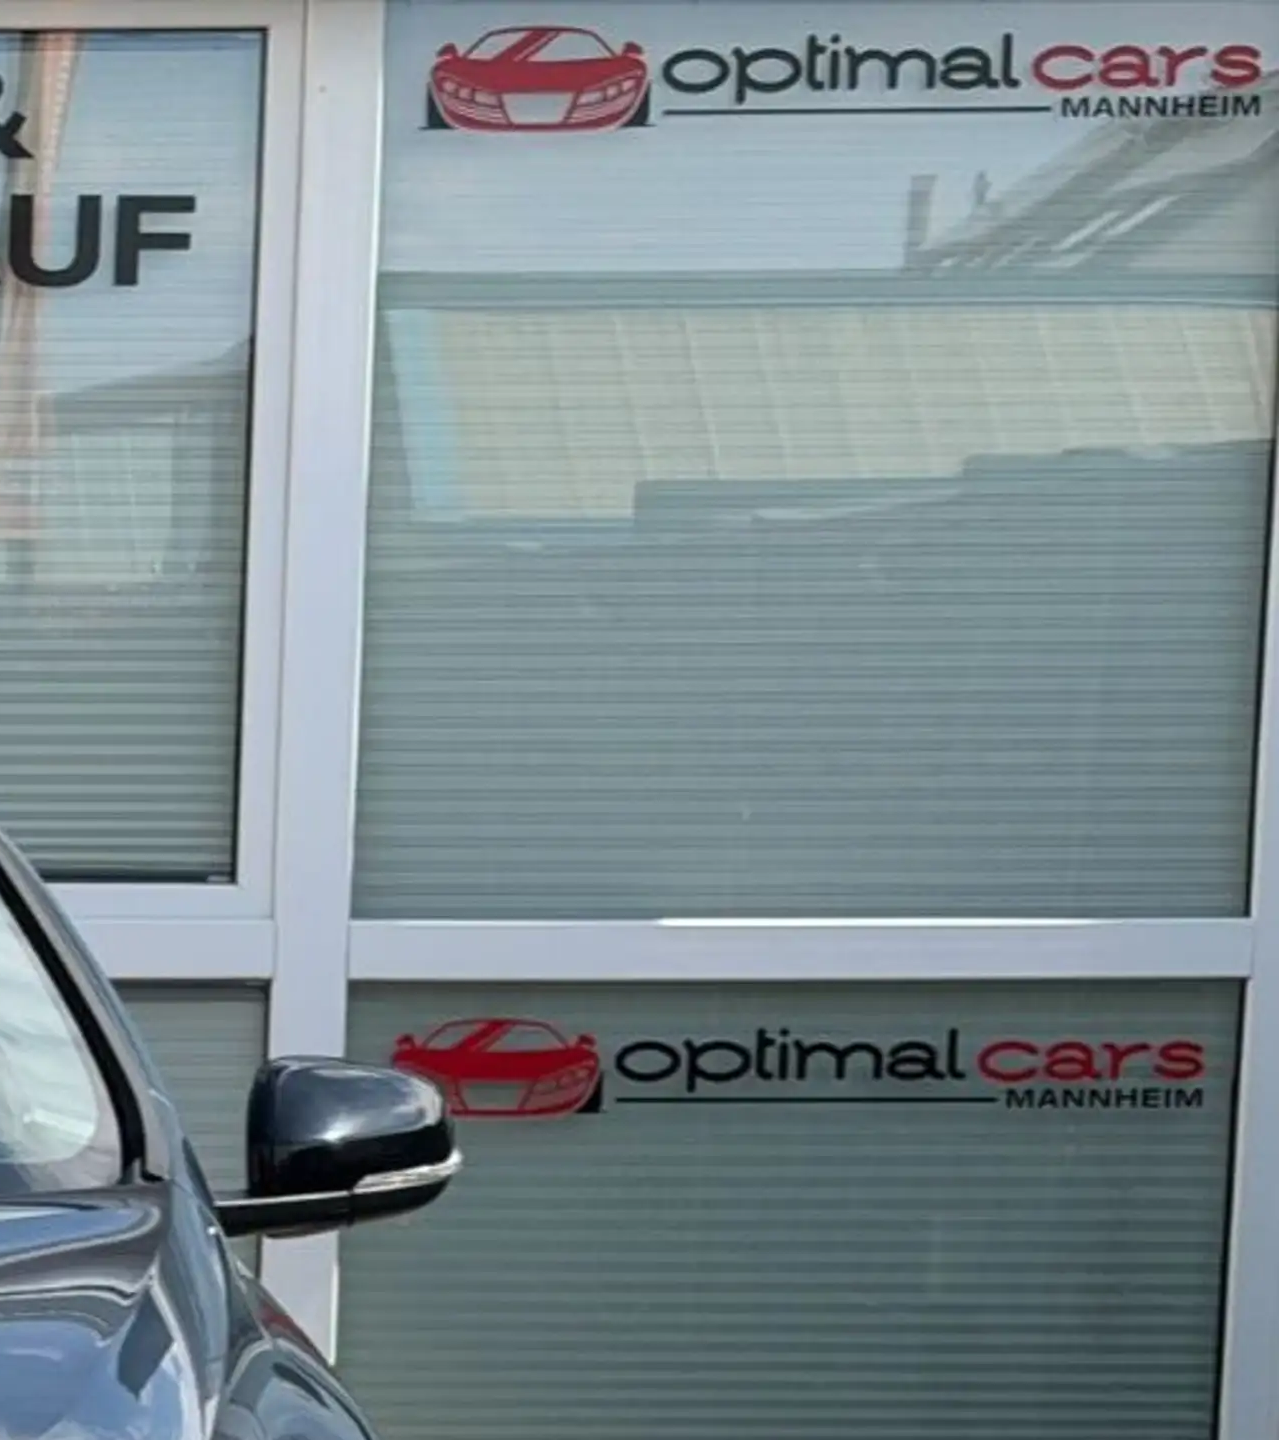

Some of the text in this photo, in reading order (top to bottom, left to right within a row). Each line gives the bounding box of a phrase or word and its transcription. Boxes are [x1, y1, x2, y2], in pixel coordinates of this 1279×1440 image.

[661, 33, 1262, 105] optimal cars
[1060, 96, 1261, 118] MANNHEIM
[614, 1027, 1205, 1093] optimal cars
[1005, 1089, 1203, 1109] MANNHEIM
